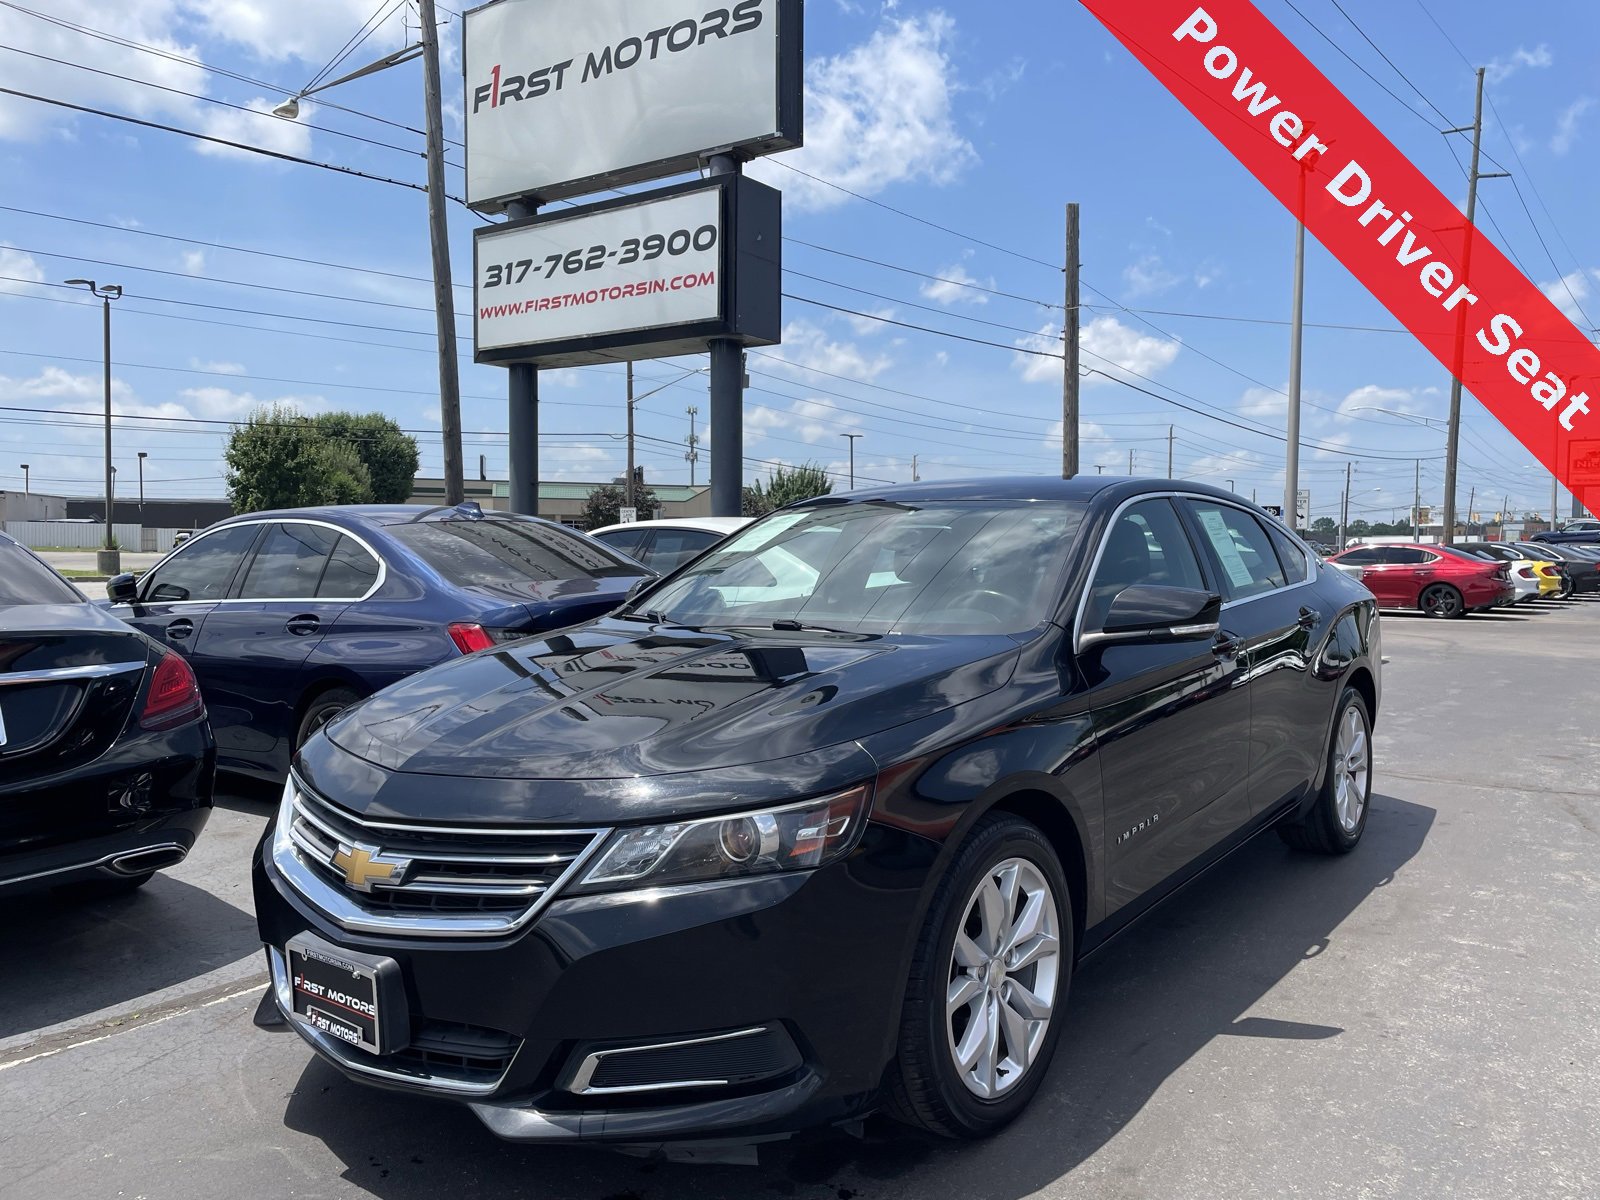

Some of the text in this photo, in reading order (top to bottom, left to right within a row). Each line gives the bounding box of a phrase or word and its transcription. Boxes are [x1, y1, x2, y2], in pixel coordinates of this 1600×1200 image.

[581, 0, 763, 83] MOTORS
[483, 224, 717, 288] 317-762-3900
[479, 271, 715, 320] WWW.FIRSTMOTORSIN.COM
[1116, 813, 1159, 846] IMPALA
[327, 989, 375, 1015] MOTORS
[330, 1022, 358, 1044] MOTORS
